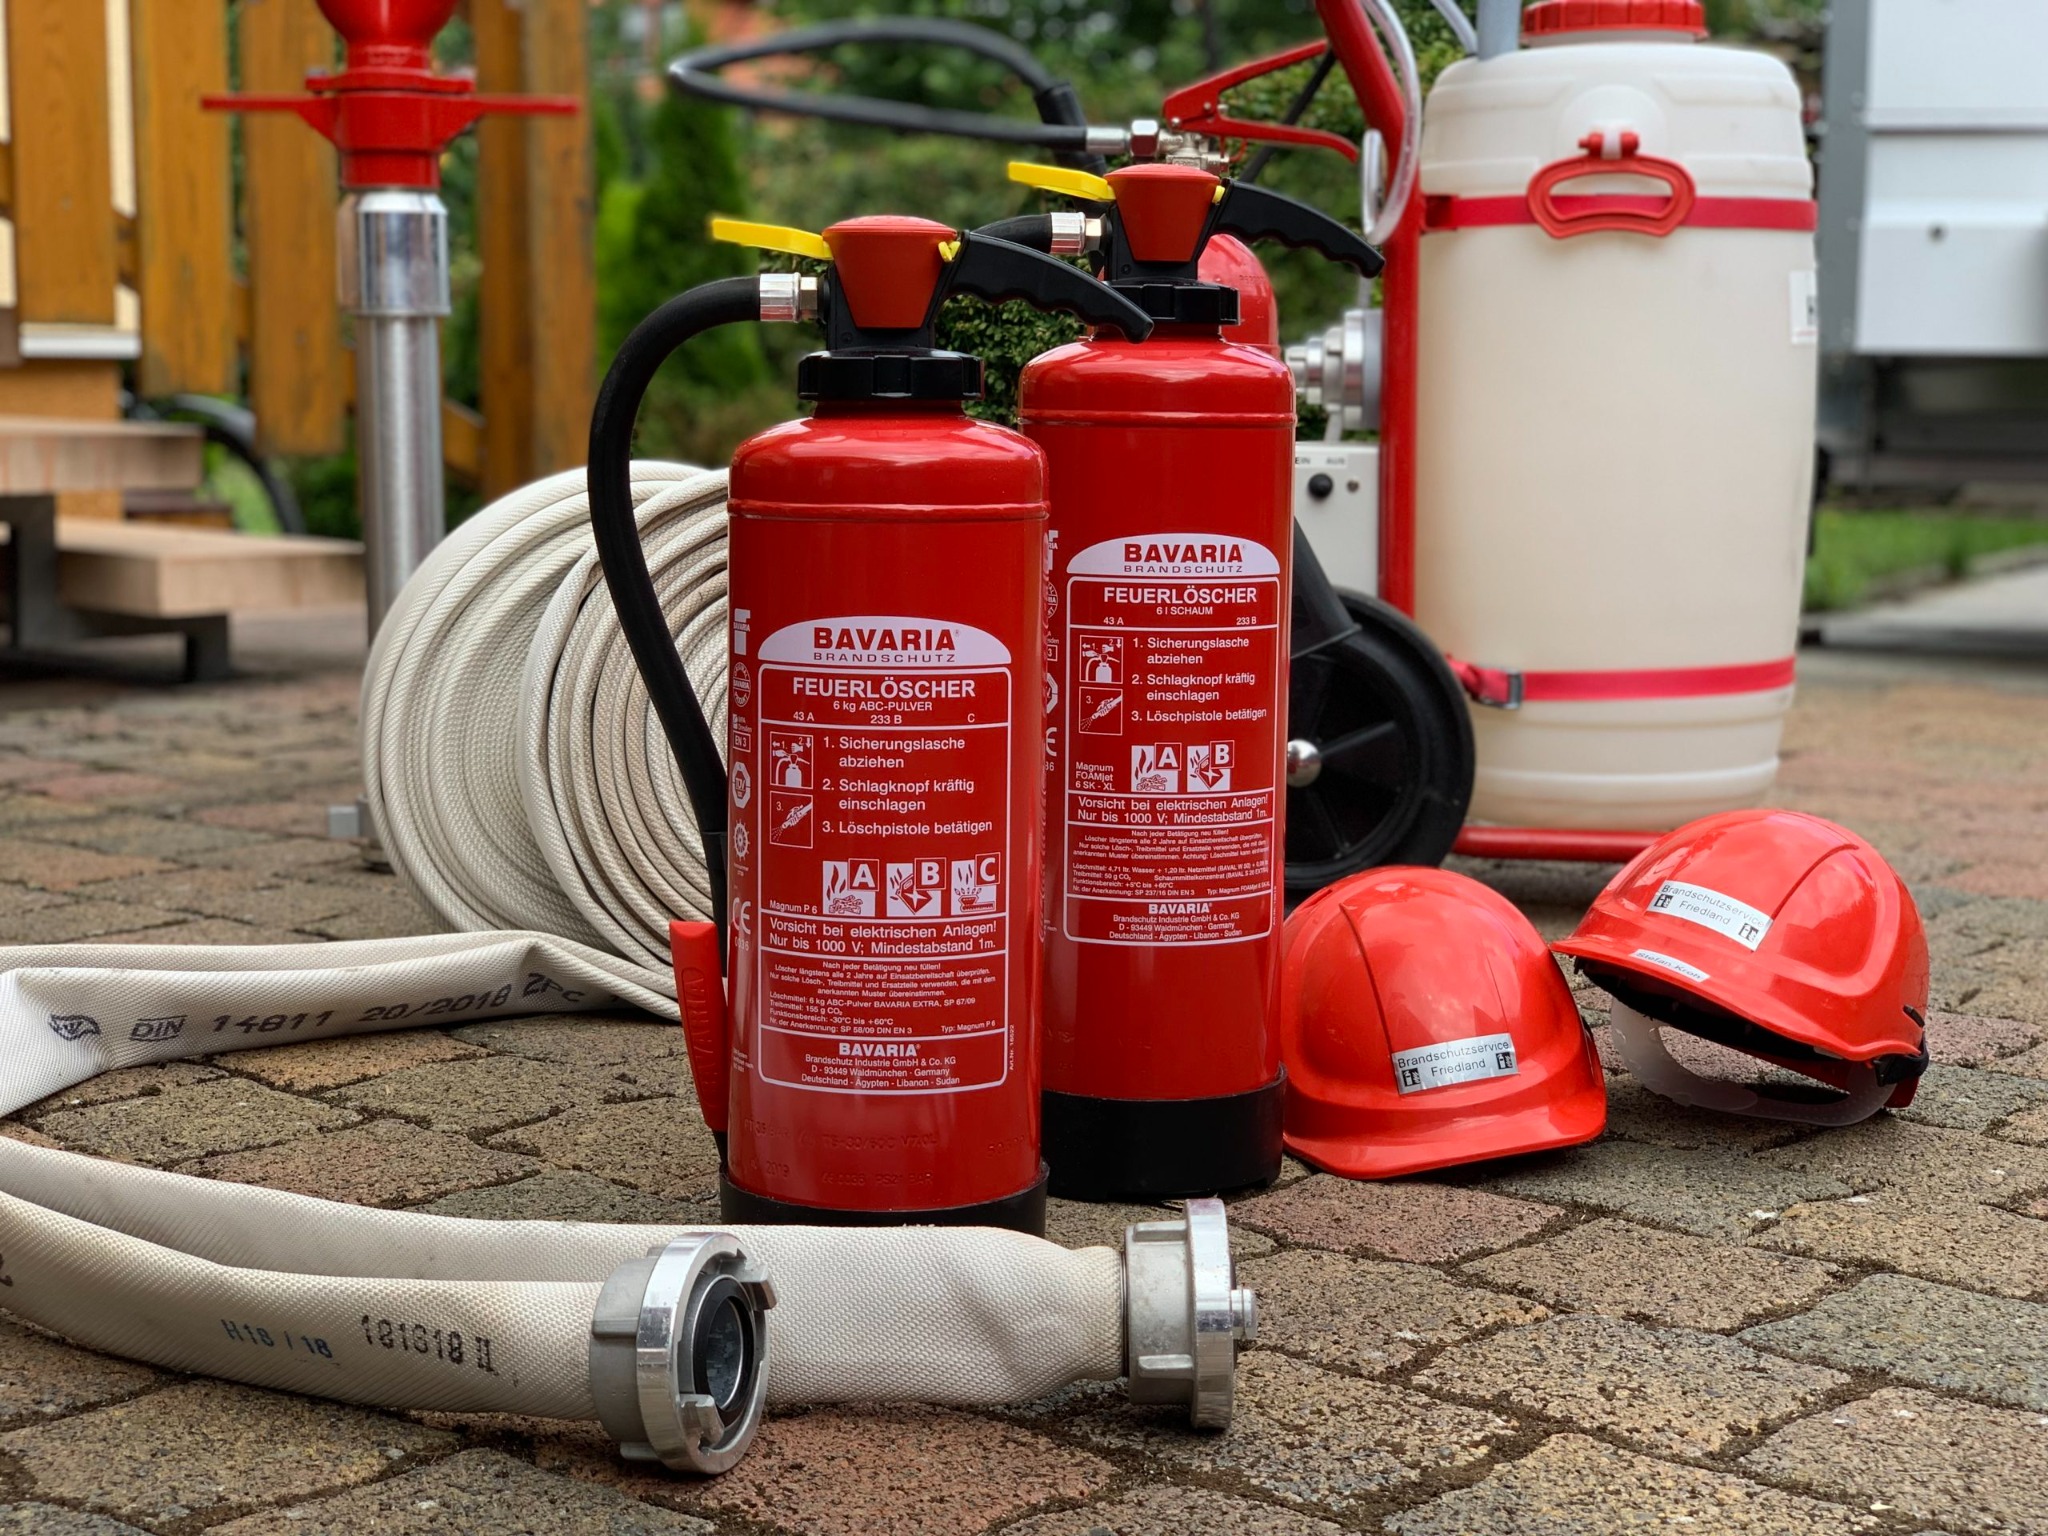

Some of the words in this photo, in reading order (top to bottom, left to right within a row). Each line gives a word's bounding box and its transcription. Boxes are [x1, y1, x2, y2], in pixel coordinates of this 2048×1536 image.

[1124, 543, 1243, 563] BAVARIA
[1124, 565, 1243, 574] BRANDSCHUTZ
[1104, 585, 1257, 604] FEUERLÖSCHER
[1156, 607, 1163, 615] 6
[1170, 607, 1213, 615] SCHAUM
[1103, 617, 1115, 625] 43
[1117, 617, 1124, 625] A
[1236, 617, 1250, 625] 233
[1251, 616, 1257, 625] B
[814, 627, 955, 651] BAVARIA
[1133, 638, 1143, 648] 1.
[1147, 637, 1249, 651] Sicherungslasche
[814, 653, 955, 663] BRANDSCHUTZ
[1147, 652, 1203, 665] abziehen
[793, 676, 975, 699] FEUERLÖSCHER
[1132, 674, 1143, 685] 2.
[1147, 674, 1222, 688] Schlagknopf
[1225, 672, 1255, 686] kräftig
[1146, 689, 1219, 704] einschlagen
[833, 701, 840, 710] 6
[843, 701, 856, 713] kg
[859, 701, 932, 711] ABC-PULVER
[793, 711, 804, 720] 43
[807, 712, 815, 721] A
[870, 715, 891, 724] 233
[894, 715, 902, 724] B
[967, 713, 976, 723] C
[1131, 711, 1142, 721] 3.
[1146, 709, 1223, 724] Löschpistole
[1225, 708, 1267, 722] betätigen
[824, 736, 835, 748] 1.
[839, 736, 965, 753] Sicherungslasche
[839, 755, 904, 768] abziehen
[1157, 747, 1178, 768] A
[1215, 744, 1229, 765] B
[1076, 762, 1113, 773] Magnum
[1076, 771, 1113, 783] FOAMjet
[822, 778, 835, 791] 2.
[839, 779, 930, 795] Schlagknopf
[933, 778, 974, 793] kräftig
[1083, 781, 1095, 789] SK
[1103, 783, 1115, 791] XL
[839, 797, 926, 814] einschlagen
[1078, 796, 1125, 810] Vorsicht
[1131, 799, 1149, 810] bei
[1156, 799, 1226, 811] elektrischen
[1231, 794, 1268, 808] Anlagen!
[1078, 809, 1097, 821] Nur
[1102, 811, 1118, 822] bis
[1124, 812, 1151, 823] 1000
[1157, 812, 1168, 825] V;
[1174, 809, 1252, 823] Mindestabstand
[822, 821, 835, 833] 3.
[839, 820, 930, 837] Löschpistole
[934, 820, 992, 835] betätigen
[852, 863, 875, 888] A
[921, 862, 939, 885] B
[979, 857, 996, 881] C
[769, 900, 802, 912] Magnum
[804, 904, 810, 913] P
[812, 906, 818, 914] 6
[1148, 903, 1210, 914] BAVARIA
[1661, 884, 1764, 928] Brandschutzservice
[1678, 900, 1731, 926] Friedland
[1113, 914, 1157, 923] Brandschutz
[1158, 914, 1189, 923] Industrie
[1190, 915, 1211, 923] GmbH
[1208, 922, 1235, 930] Germany
[770, 917, 817, 935] Vorsicht
[823, 924, 844, 937] bei
[850, 925, 936, 938] elektrischen
[943, 920, 996, 937] Anlagen!
[1109, 931, 1153, 939] Deutschland
[770, 932, 788, 947] Nur
[792, 937, 809, 949] bis
[816, 939, 845, 952] 1000
[852, 941, 864, 955] V;
[871, 939, 973, 954] Mindestabstand
[979, 938, 995, 949] 1m.
[775, 964, 797, 973] Löscher
[799, 967, 829, 978] längstens
[832, 970, 844, 978] alle
[890, 971, 954, 980] Einsatzbereitschaft
[823, 961, 840, 969] Nach
[843, 962, 860, 971] jeder
[863, 963, 901, 972] Betätigung
[781, 974, 799, 983] solche
[828, 979, 862, 988] Treibmittel
[818, 988, 859, 996] anerkannten
[816, 997, 825, 1006] kg
[827, 999, 871, 1007] ABC-Pulver
[130, 1016, 187, 1042] DIN
[212, 1010, 335, 1034] 14811
[358, 984, 512, 1022] 20/2018
[779, 1018, 789, 1026] der
[957, 1022, 985, 1031] Magnum
[839, 1042, 917, 1057] BAVARIA
[1398, 1040, 1509, 1069] Brandschutzservice
[805, 1054, 852, 1065] Brandschutz
[855, 1058, 890, 1067] Industrie
[893, 1057, 918, 1066] GmbH
[929, 1057, 942, 1066] Co.
[944, 1056, 956, 1065] KG
[1431, 1059, 1486, 1077] Friedland
[824, 1066, 847, 1075] 93449
[850, 1066, 907, 1077] Waldmünchen
[914, 1067, 950, 1077] Germany
[801, 1073, 848, 1085] Deutschland
[855, 1077, 889, 1088] Ägypten
[897, 1077, 928, 1086] Libanon
[936, 1076, 960, 1086] Sudan
[221, 1318, 274, 1347] H18
[300, 1335, 333, 1359] 18
